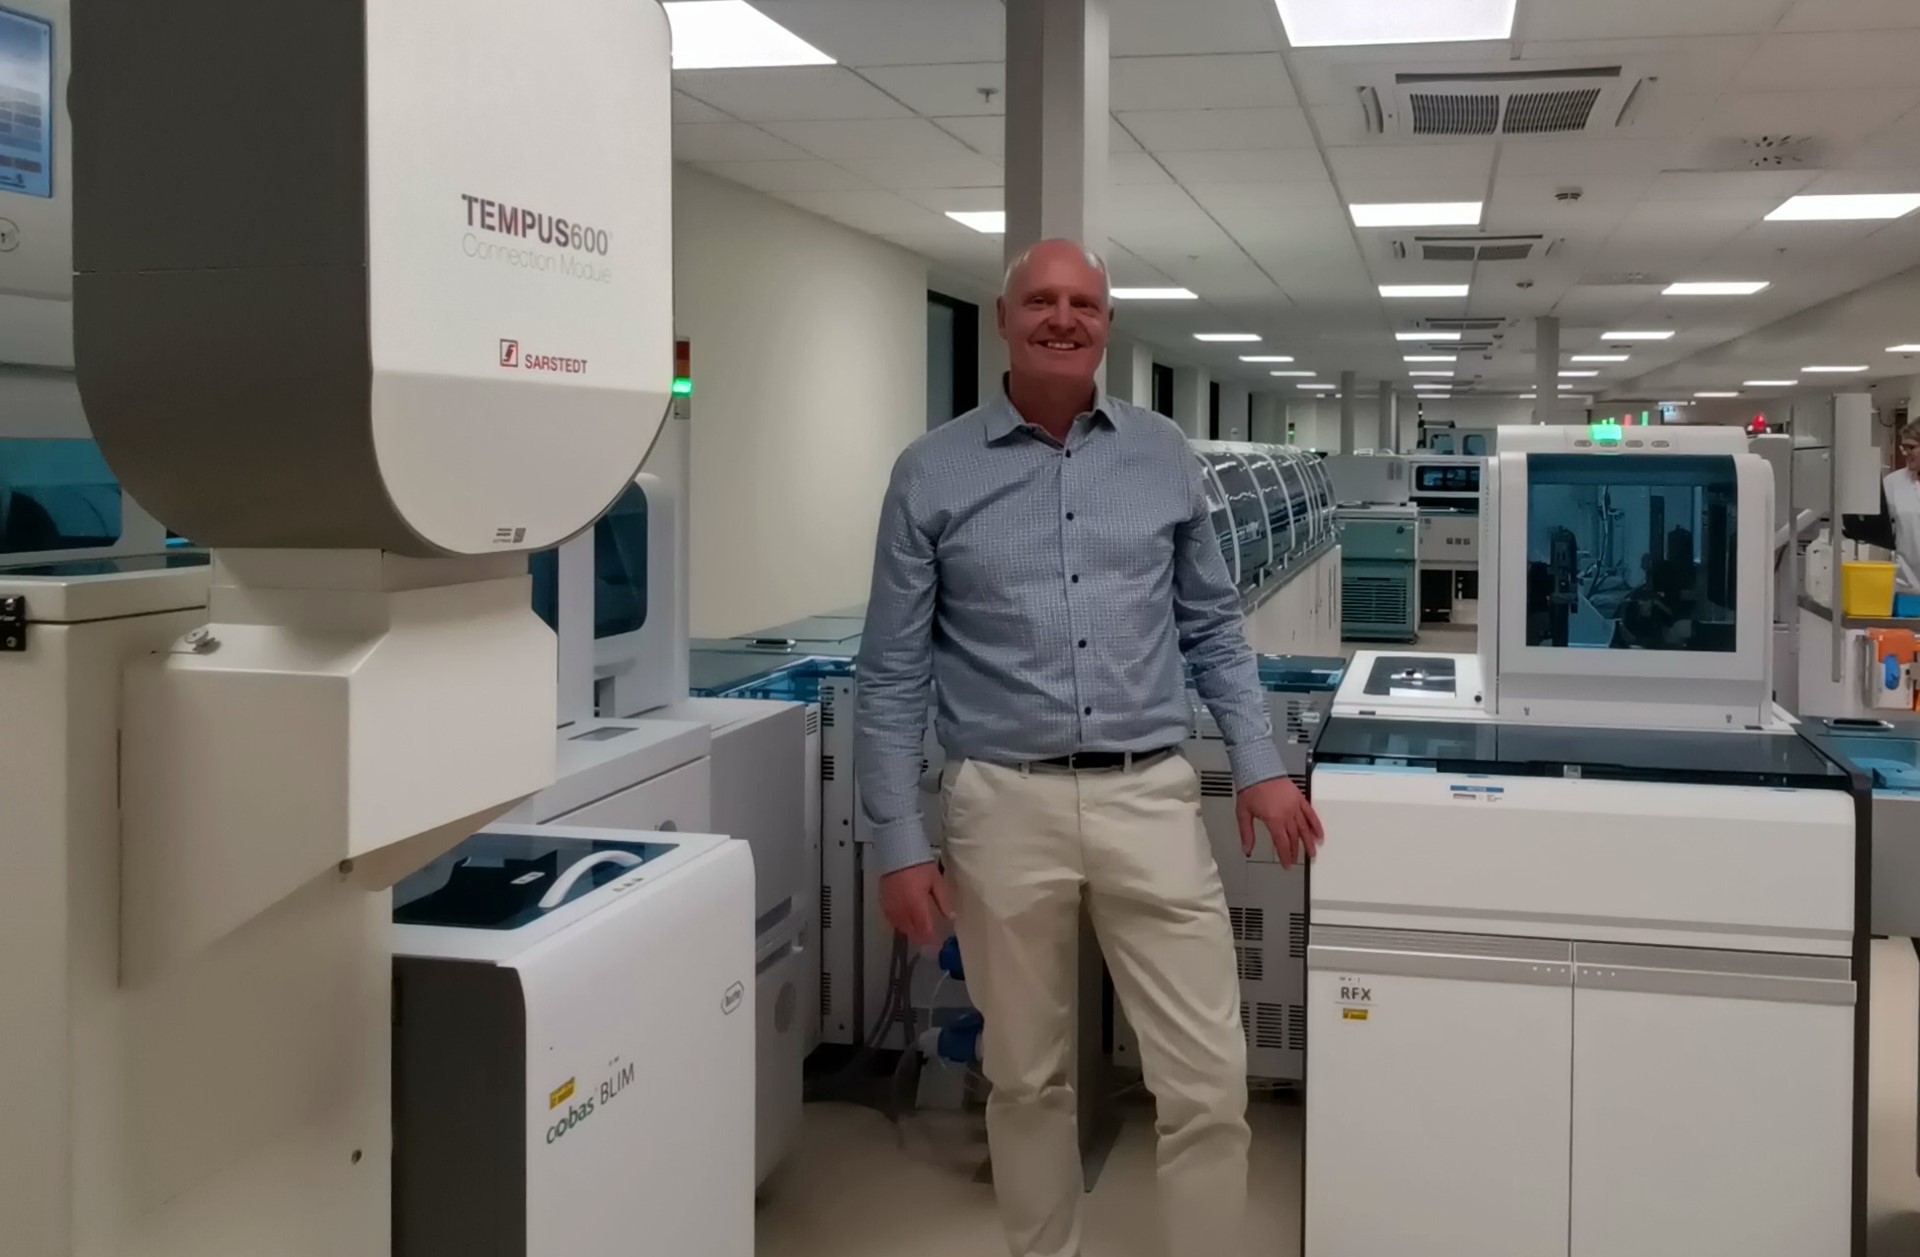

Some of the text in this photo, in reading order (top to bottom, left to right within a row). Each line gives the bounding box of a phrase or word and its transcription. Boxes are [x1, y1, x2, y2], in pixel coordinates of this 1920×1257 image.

[462, 232, 612, 284] Connection Module
[525, 354, 587, 374] SARSTEDT
[1341, 987, 1371, 1001] RFX
[546, 1097, 594, 1144] cobas
[600, 1062, 634, 1105] BLIM
